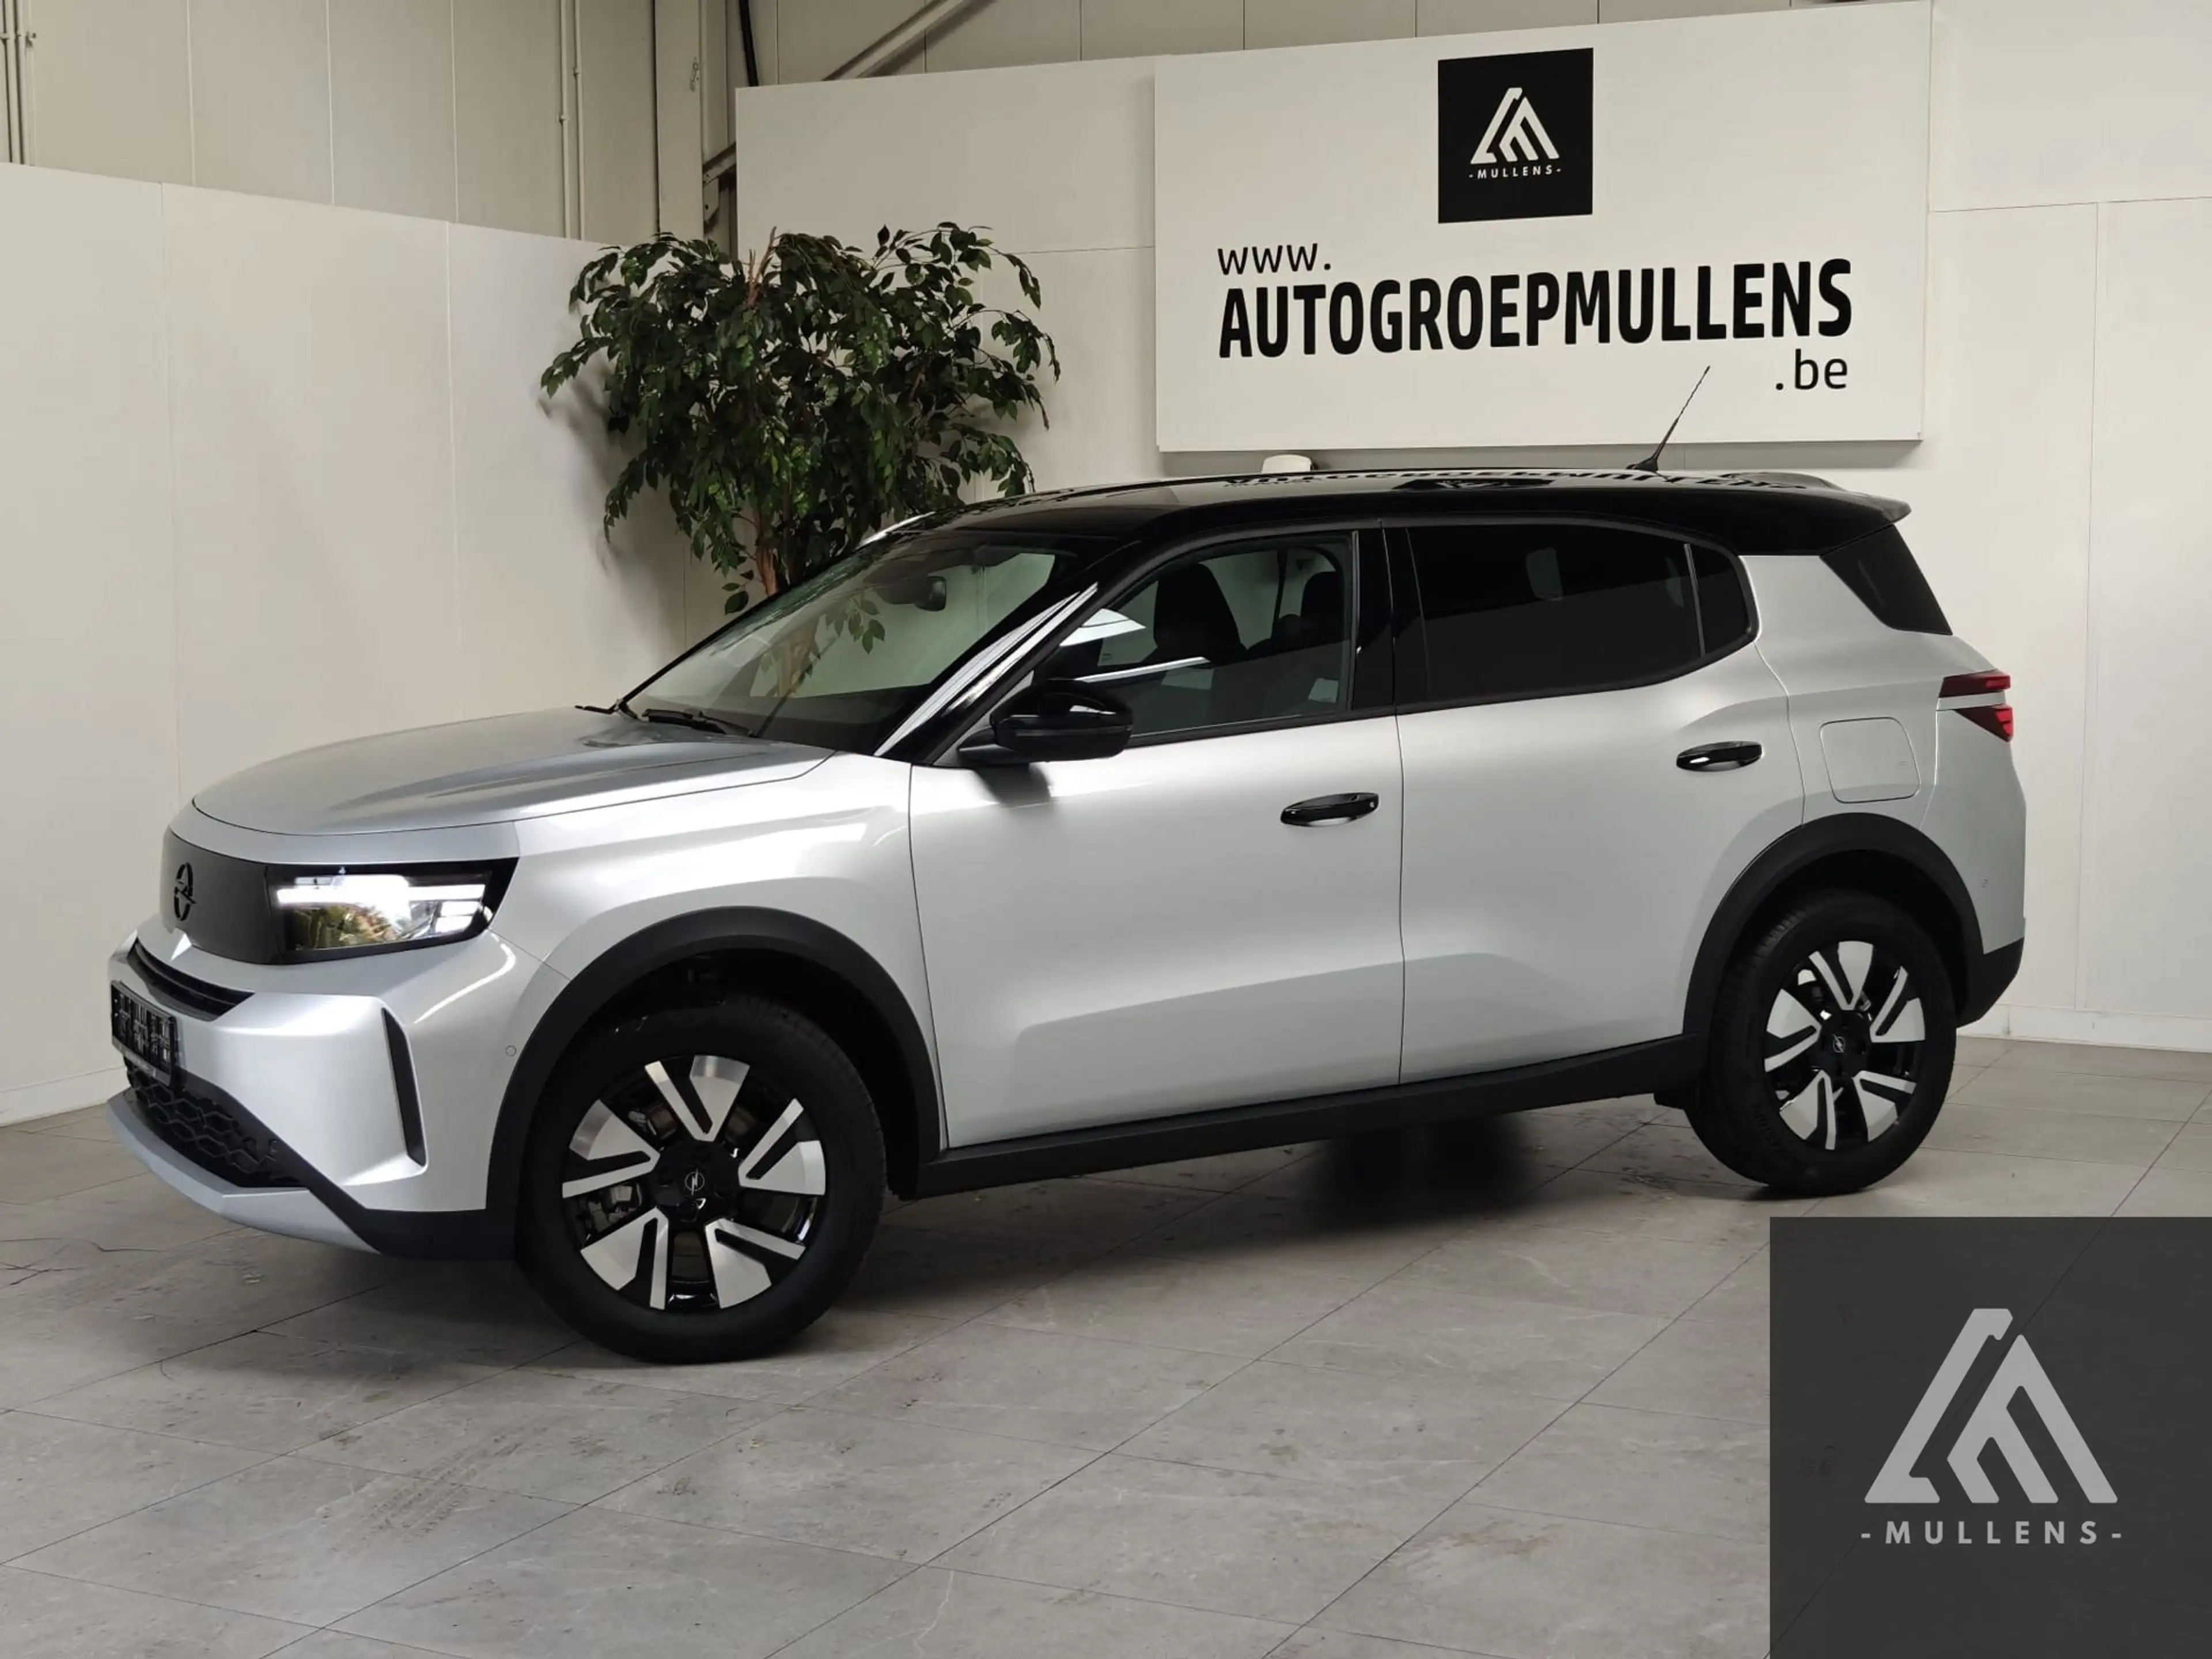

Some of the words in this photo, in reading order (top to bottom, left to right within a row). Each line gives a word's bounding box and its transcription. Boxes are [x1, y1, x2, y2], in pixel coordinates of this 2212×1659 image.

[1217, 243, 1332, 276] www.
[1218, 259, 1853, 358] AUTOGROEPMULLENS
[1775, 349, 1848, 391] .be
